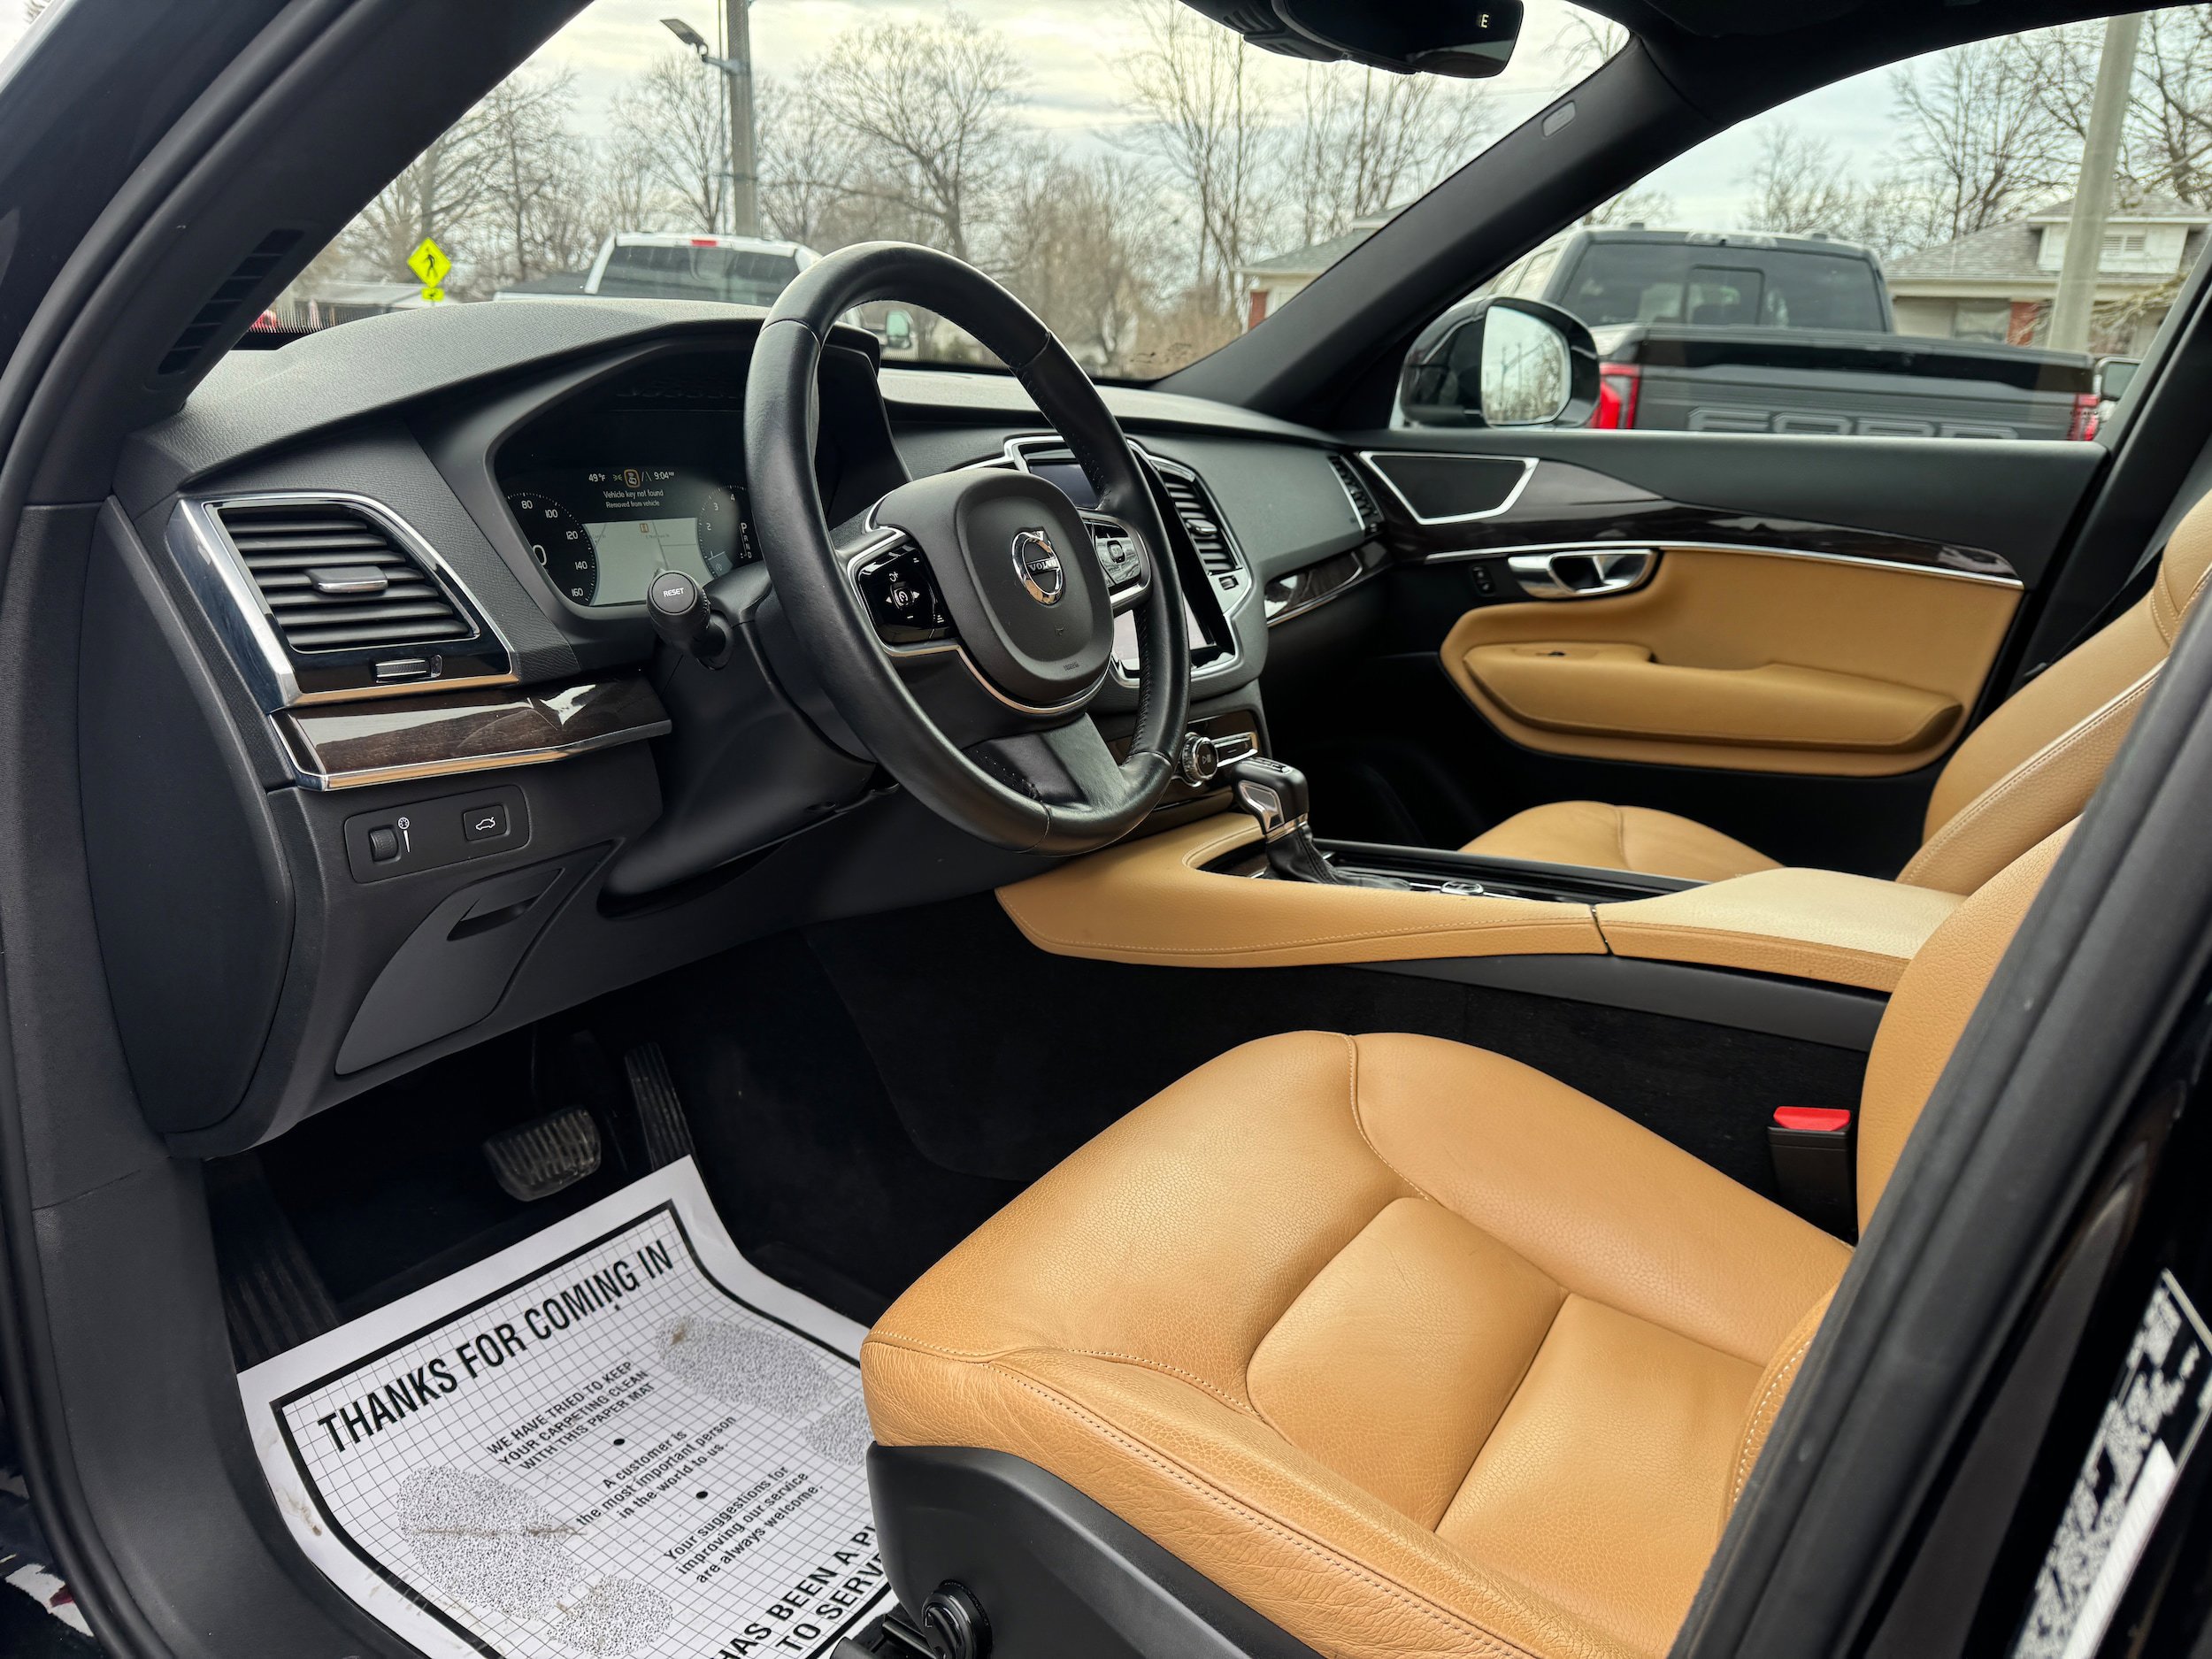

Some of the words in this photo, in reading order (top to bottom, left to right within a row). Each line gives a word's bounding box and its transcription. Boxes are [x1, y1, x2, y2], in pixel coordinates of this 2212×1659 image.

[1480, 13, 1489, 28] E
[520, 500, 534, 510] 80
[544, 509, 558, 518] 100
[603, 490, 626, 499] Vehicle
[625, 490, 636, 500] key
[647, 488, 664, 497] found
[713, 502, 718, 511] 3
[565, 530, 579, 541] 120
[574, 560, 588, 571] 140
[1027, 558, 1057, 572] VOLVO
[571, 588, 584, 597] 160
[663, 587, 685, 598] RESET
[317, 1358, 457, 1453] THANKS
[456, 1324, 527, 1379] FOR
[524, 1260, 641, 1340] COMING
[636, 1239, 674, 1279] IN
[487, 1436, 512, 1455] WE
[511, 1414, 549, 1440] HAVE
[545, 1392, 585, 1418] TRIED
[583, 1380, 603, 1395] TO
[602, 1361, 632, 1383] KEEP
[499, 1439, 541, 1466] YOUR
[538, 1394, 610, 1441] CARPETING
[608, 1370, 649, 1398] CLEAN
[518, 1444, 558, 1471] WITH
[556, 1424, 588, 1448] THIS
[587, 1400, 629, 1427] PAPER
[627, 1381, 656, 1402] MAT
[576, 1508, 602, 1526] the
[602, 1483, 637, 1510] most
[634, 1443, 697, 1487] important
[695, 1416, 737, 1448] person
[602, 1478, 617, 1489] A
[615, 1439, 675, 1481] customer
[671, 1429, 687, 1442] is
[617, 1506, 635, 1519] in
[633, 1490, 658, 1509] the
[656, 1464, 695, 1491] world
[691, 1455, 708, 1467] to
[706, 1443, 729, 1457] us.
[664, 1535, 699, 1561] Your
[696, 1479, 772, 1537] suggestions
[766, 1465, 789, 1481] for
[675, 1522, 745, 1575] improving
[742, 1504, 766, 1524] our
[763, 1472, 809, 1507] service
[695, 1564, 721, 1584] are
[719, 1526, 766, 1564] always
[763, 1485, 824, 1529] welcome.
[765, 1566, 838, 1621] BEEN
[833, 1551, 859, 1566] A
[775, 1623, 821, 1652] TO
